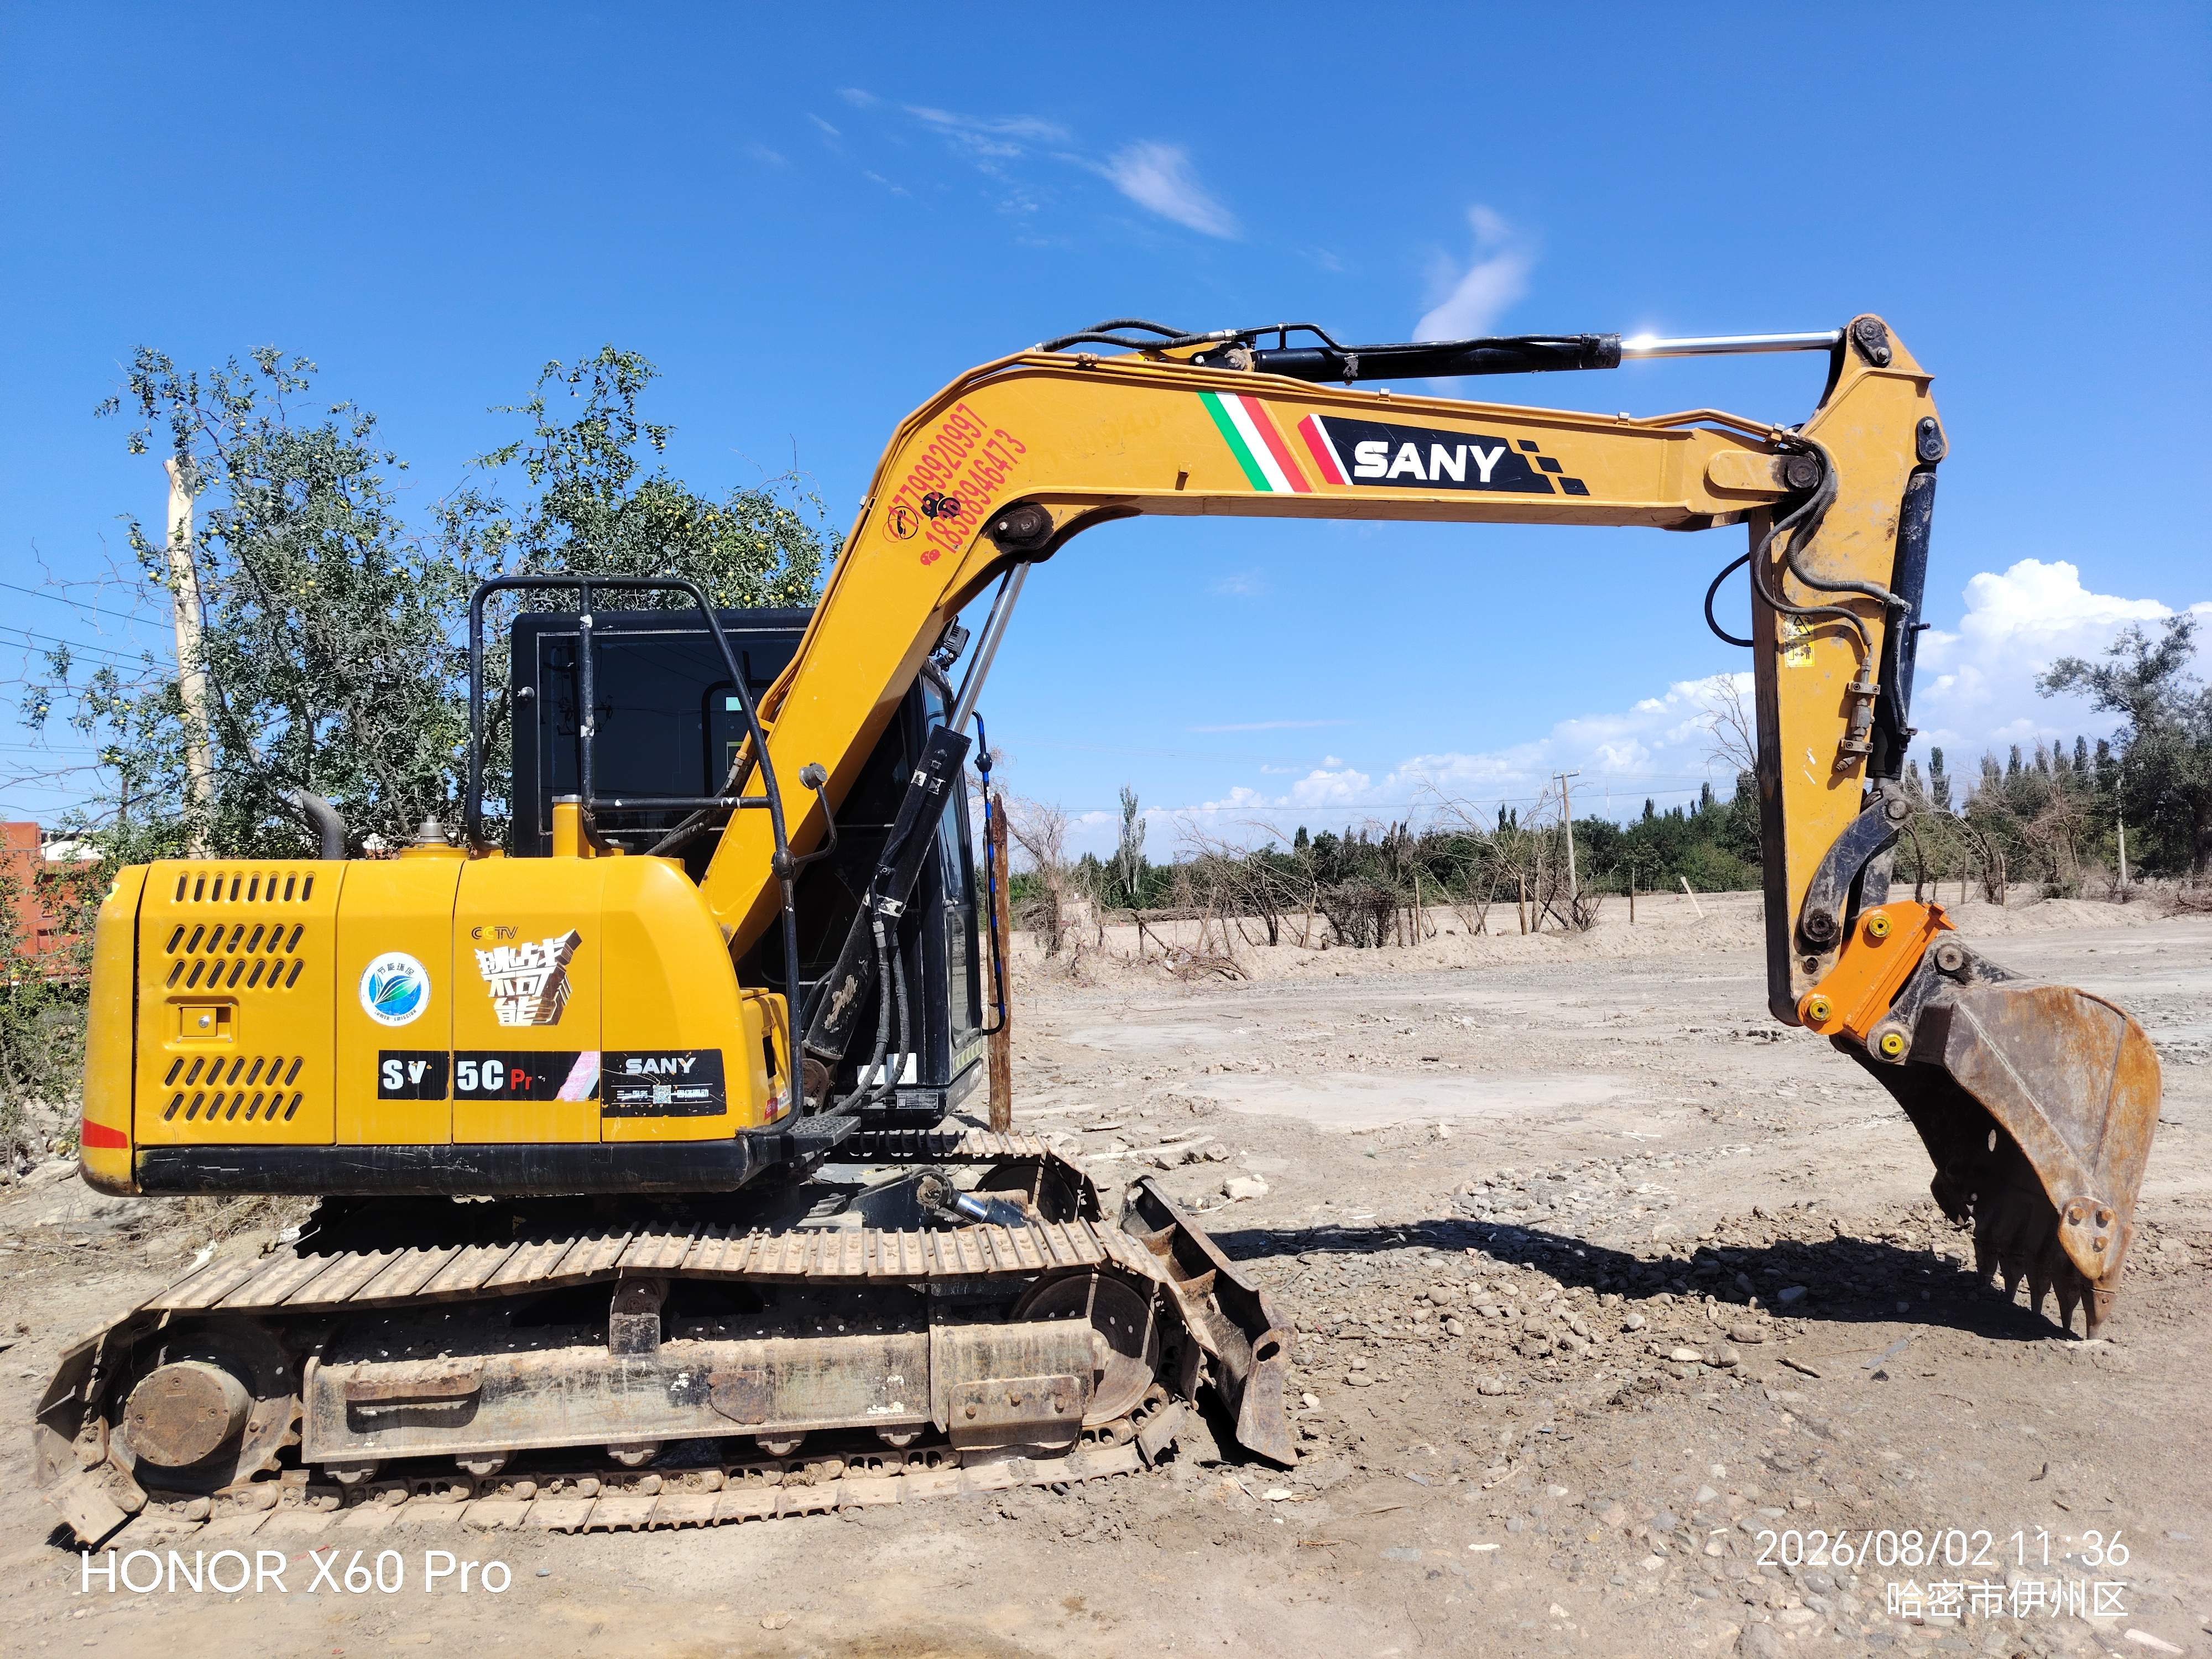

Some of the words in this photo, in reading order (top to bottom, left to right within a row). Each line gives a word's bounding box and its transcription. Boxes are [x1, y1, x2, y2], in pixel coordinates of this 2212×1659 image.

[888, 402, 988, 528] 17799920997
[1354, 441, 1505, 482] SANY
[925, 429, 1026, 554] 18388946473
[471, 926, 519, 940] CCTV
[377, 962, 415, 977] 节能环保
[625, 1057, 696, 1074] SANY
